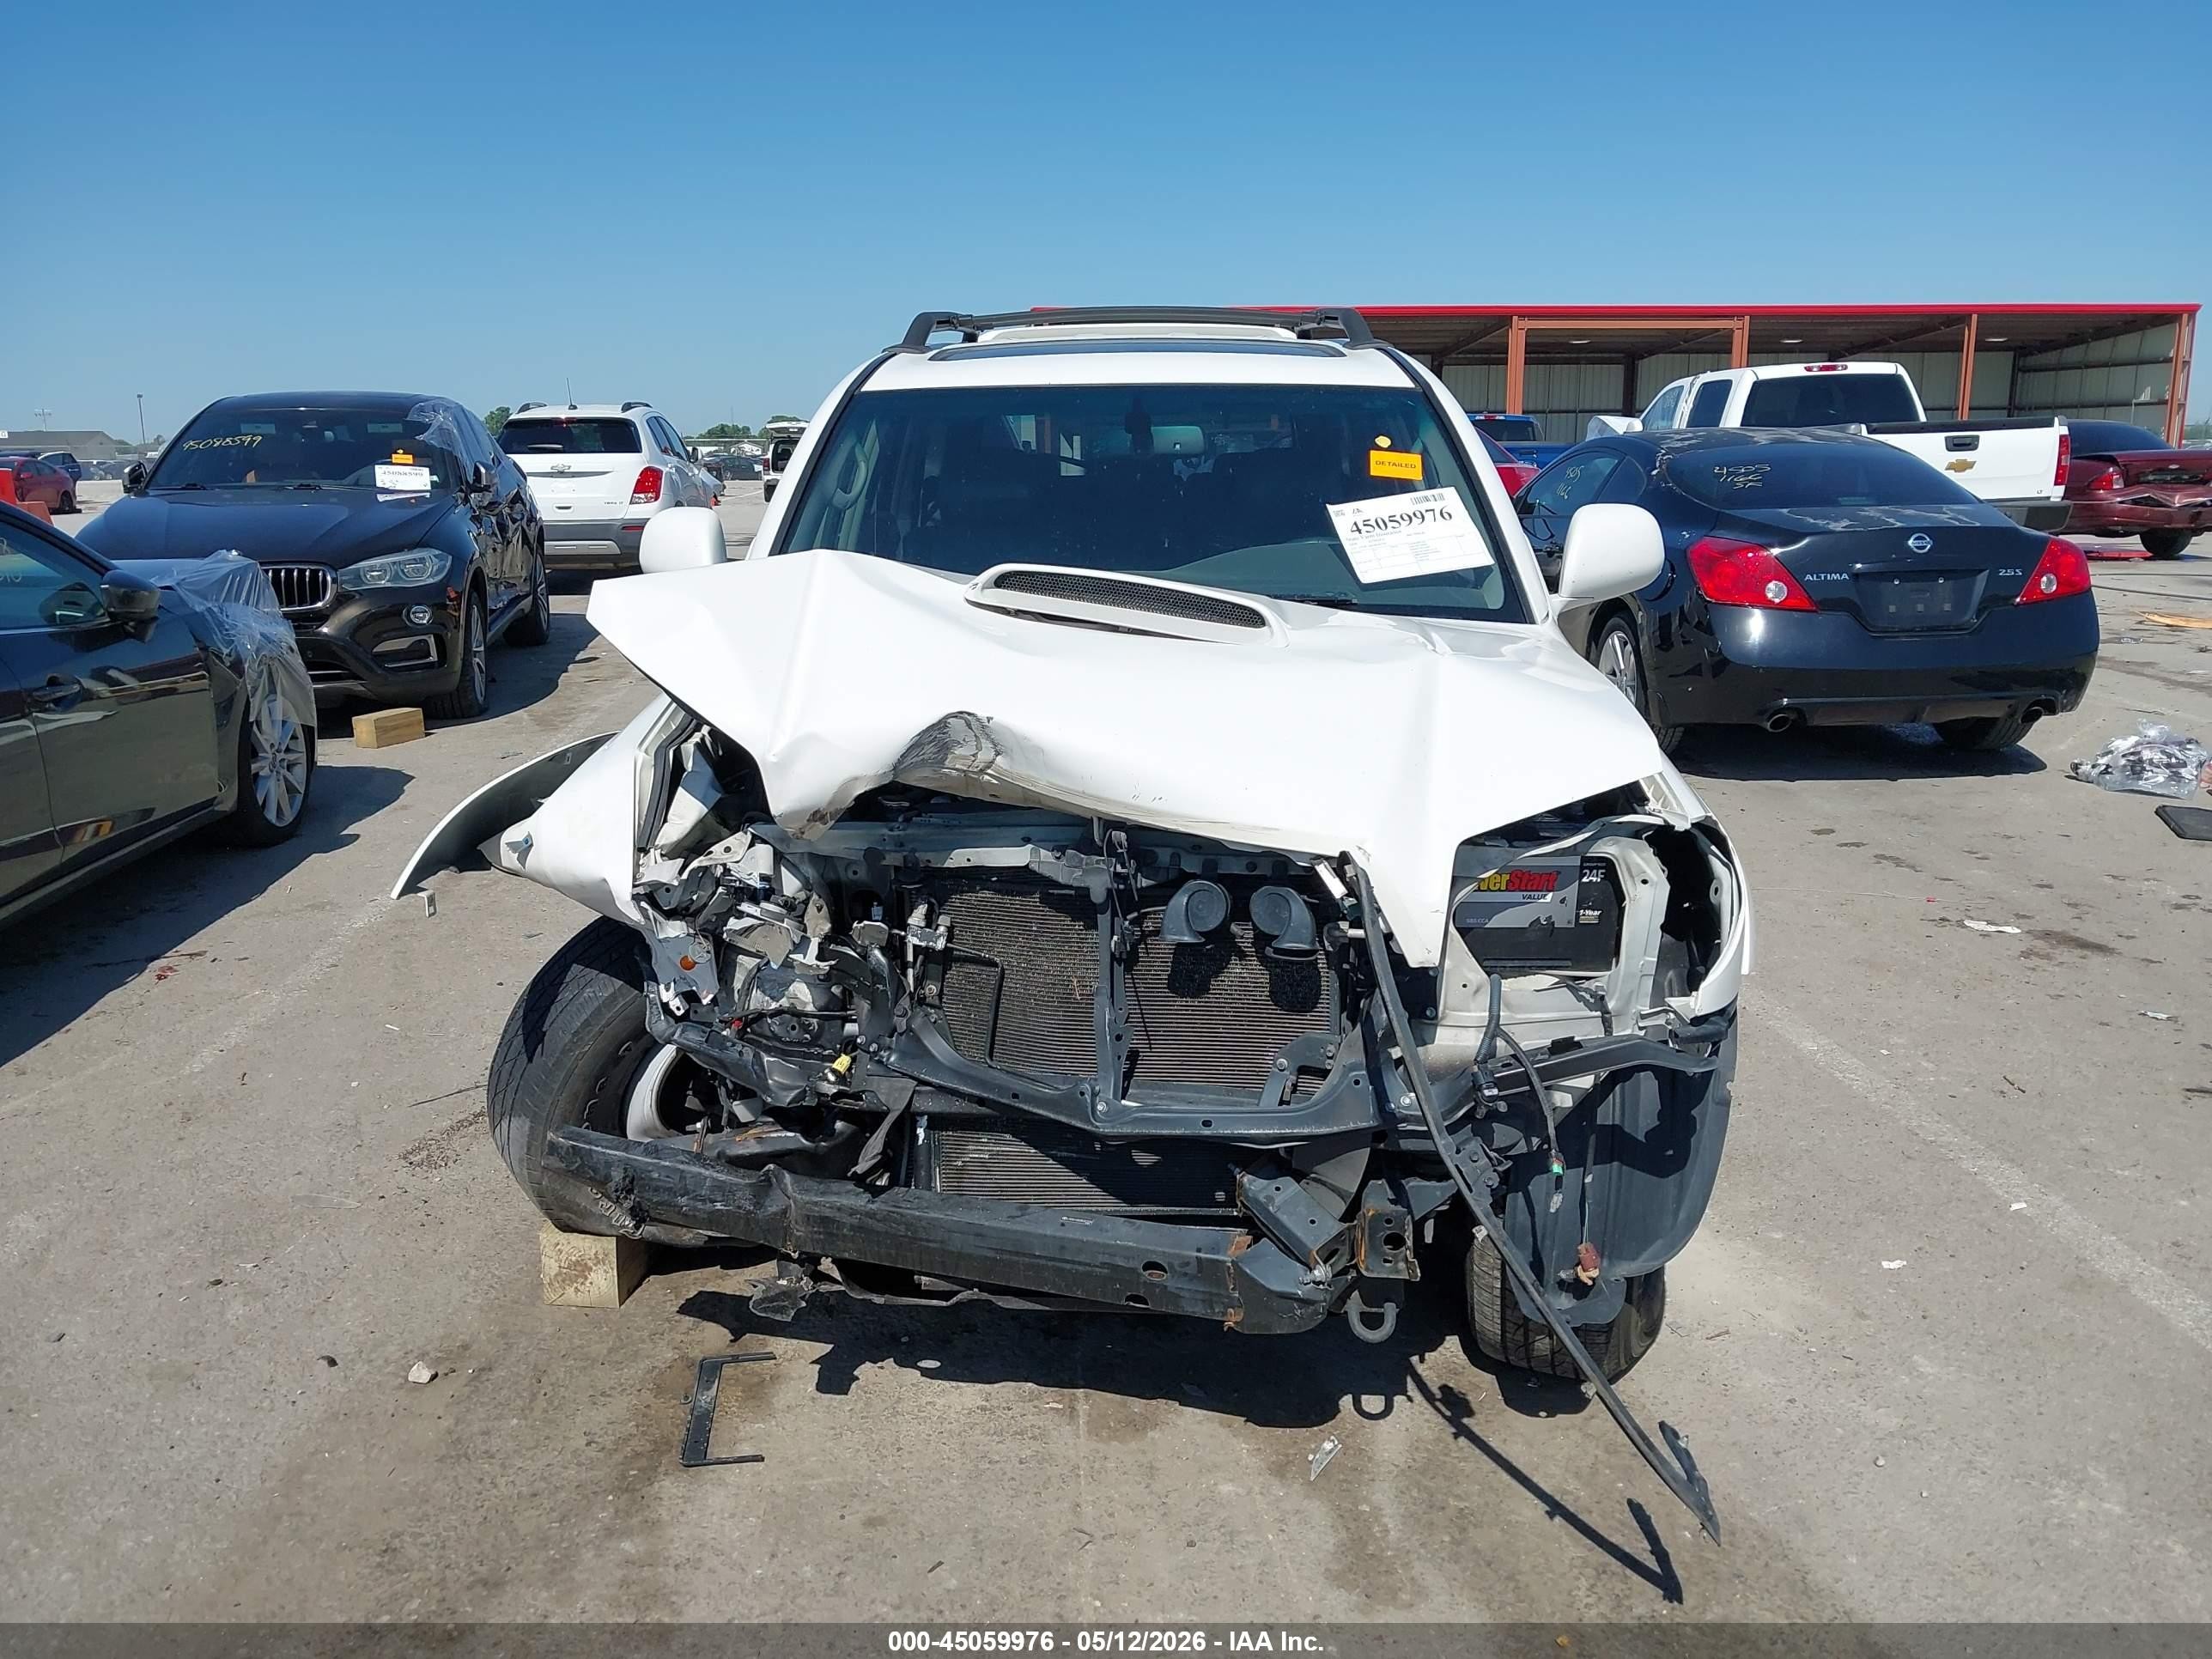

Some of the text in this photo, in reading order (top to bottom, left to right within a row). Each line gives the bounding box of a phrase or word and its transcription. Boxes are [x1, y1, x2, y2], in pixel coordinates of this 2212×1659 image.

[1375, 460, 1417, 469] DETAILED
[1350, 505, 1453, 535] 45059976
[1804, 573, 1850, 581] ALTIMA
